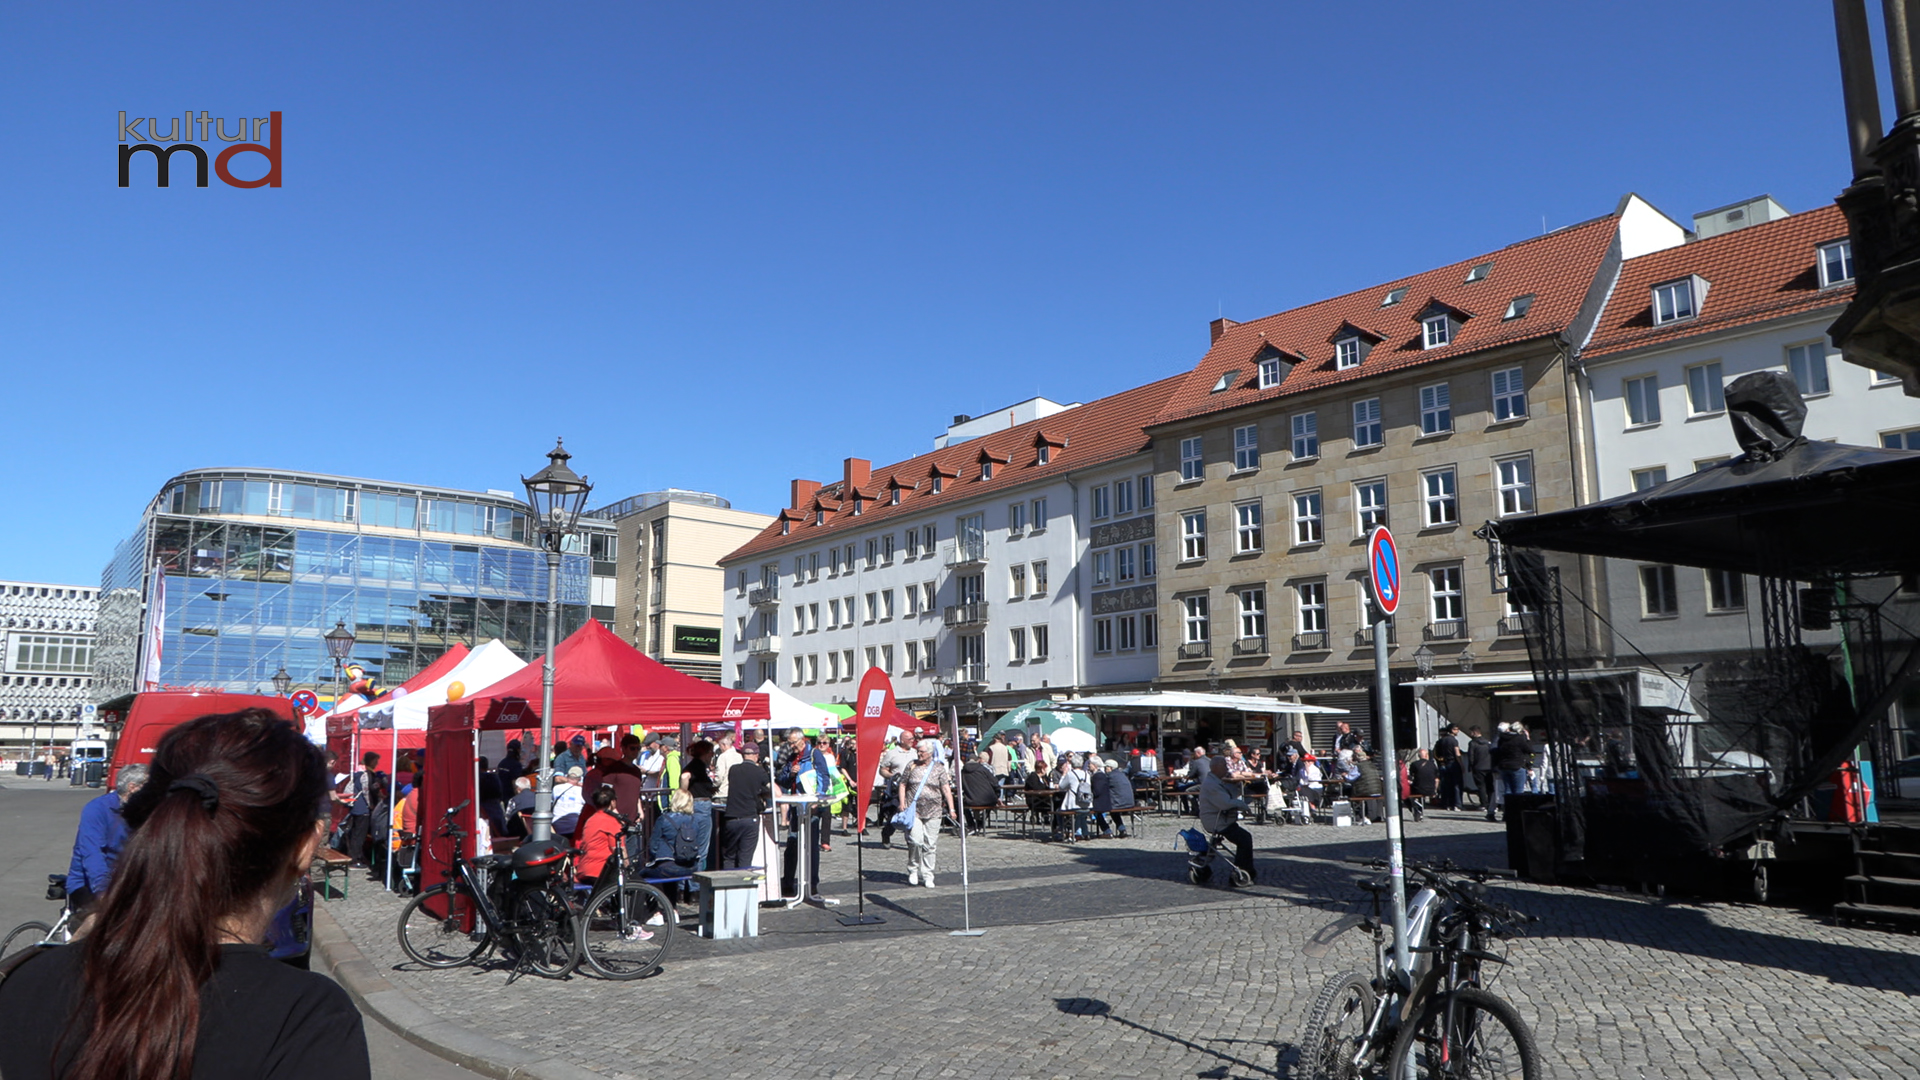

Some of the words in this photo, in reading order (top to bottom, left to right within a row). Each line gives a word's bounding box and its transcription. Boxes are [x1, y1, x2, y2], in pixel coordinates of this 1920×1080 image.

[725, 709, 742, 717] DGB
[867, 705, 881, 716] DGB
[500, 713, 519, 722] DGB
